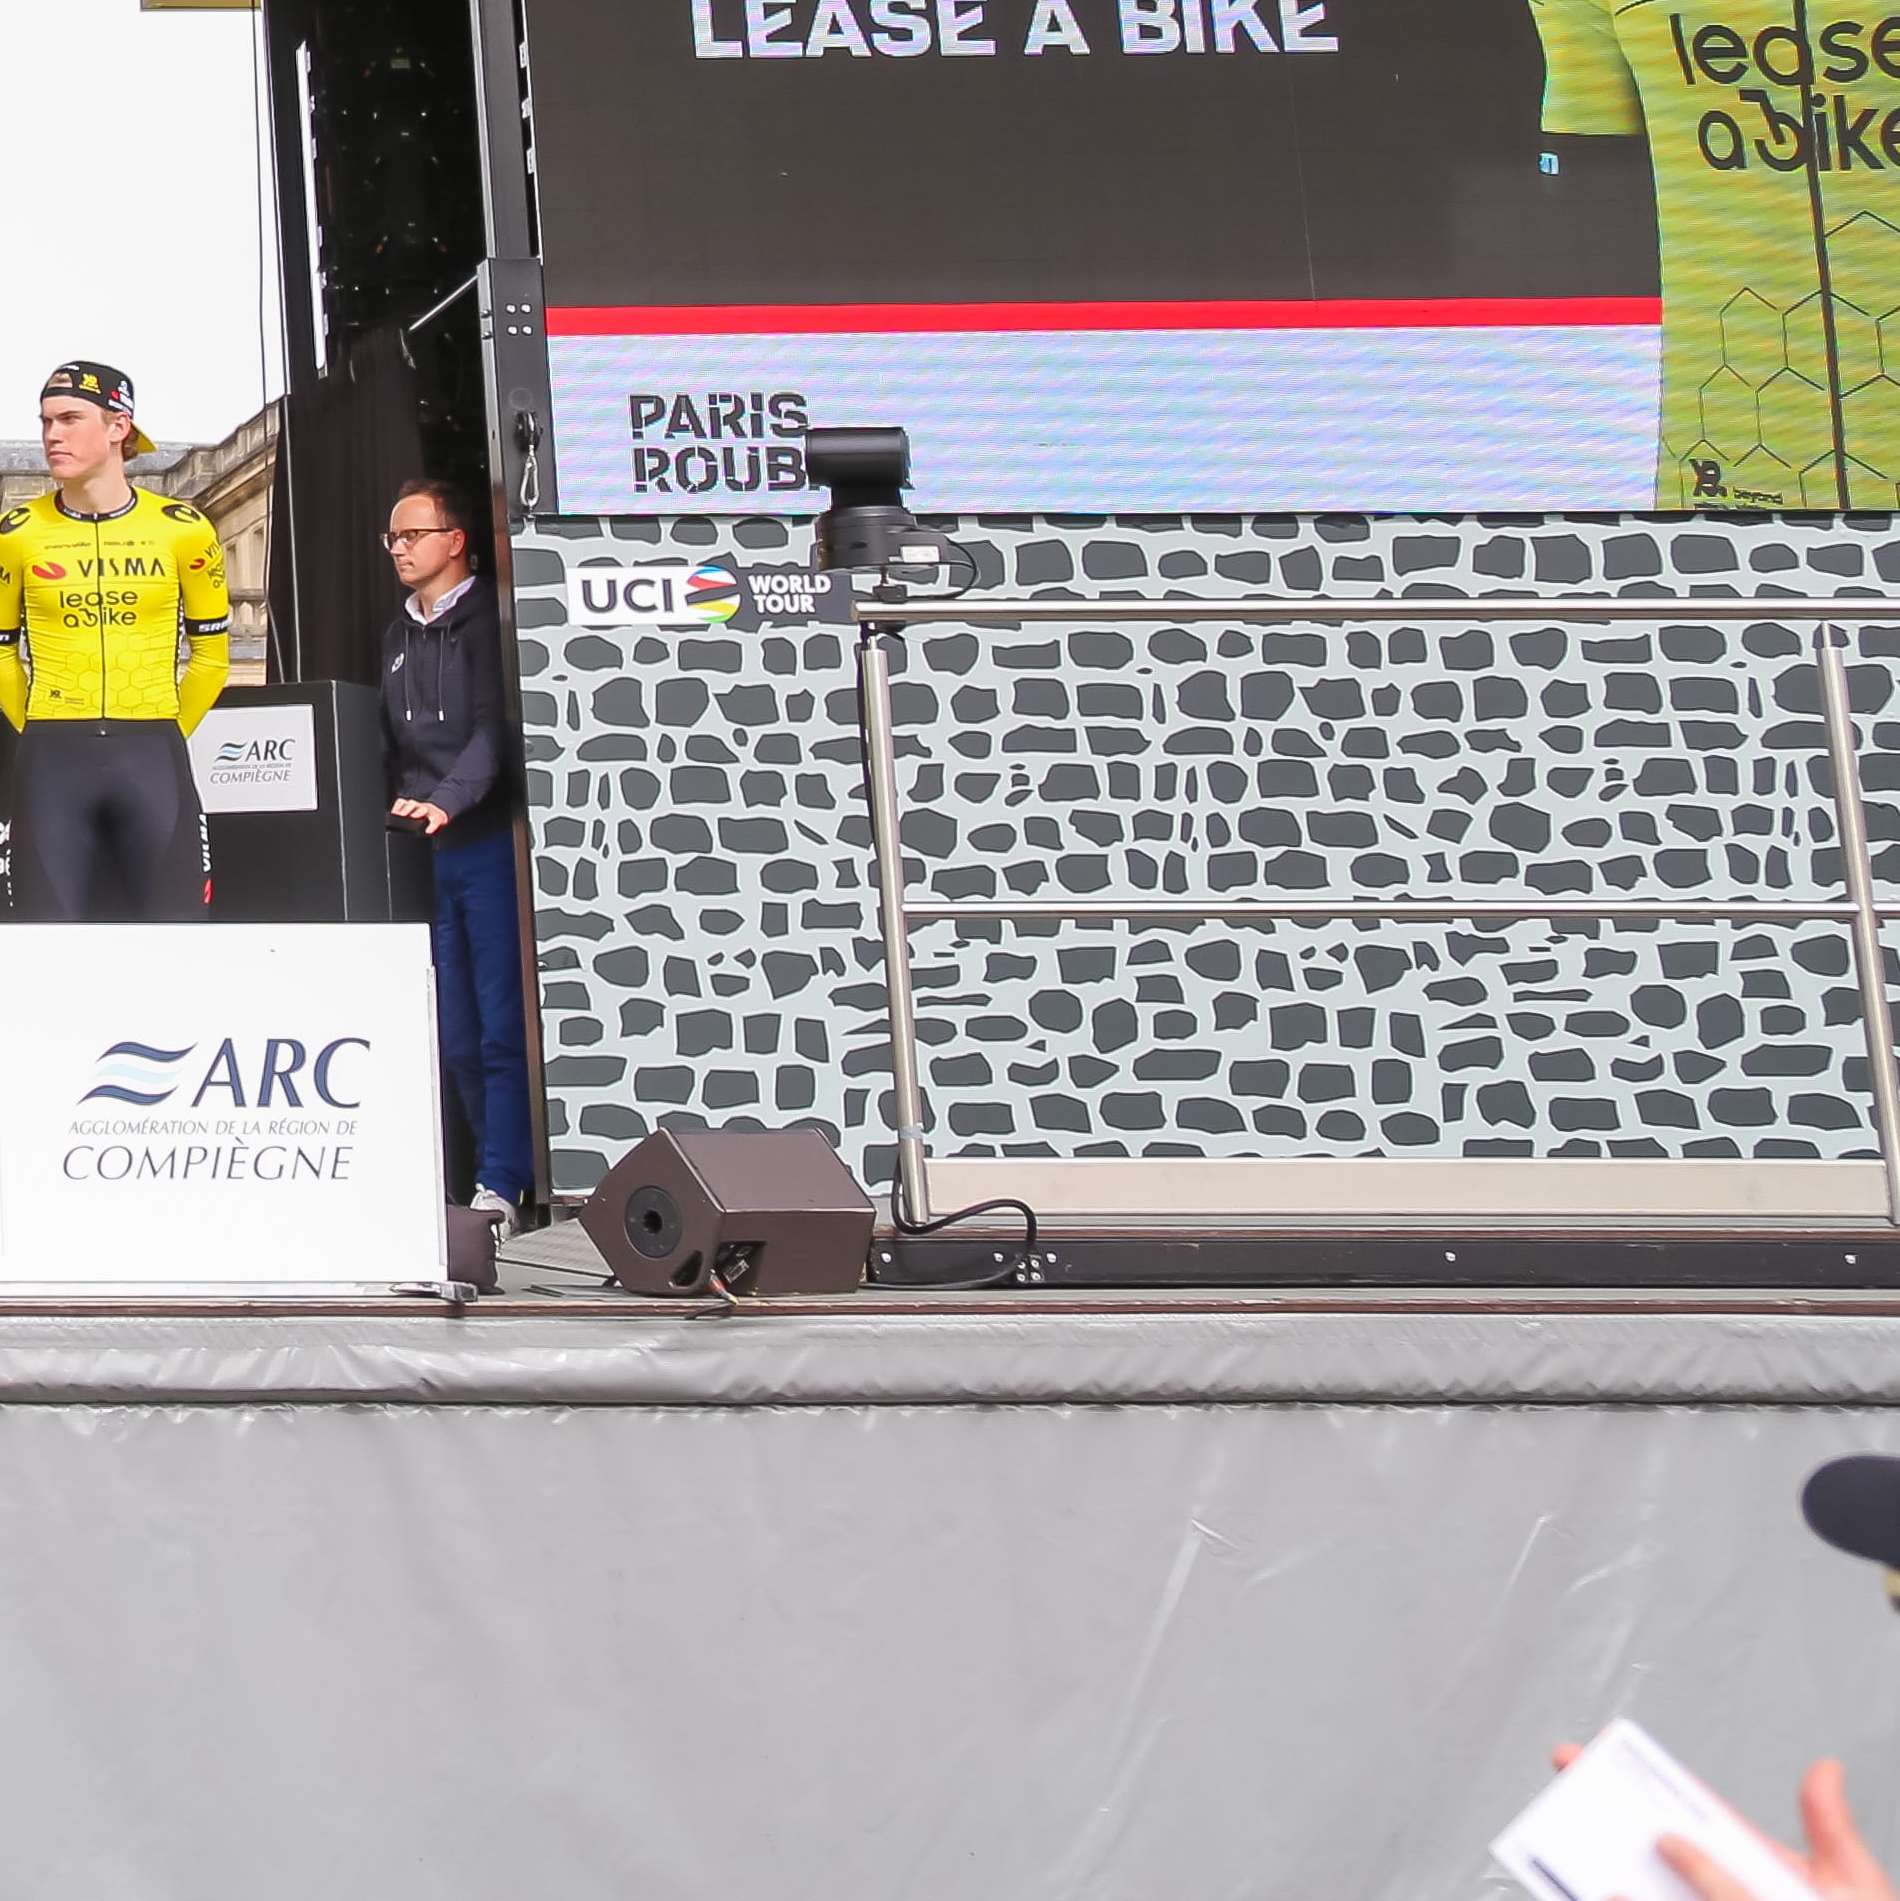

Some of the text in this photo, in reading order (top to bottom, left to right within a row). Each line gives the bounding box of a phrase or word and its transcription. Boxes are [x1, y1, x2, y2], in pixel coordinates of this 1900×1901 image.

[628, 392, 810, 439] PARIS
[632, 446, 813, 493] ROUB
[77, 557, 166, 578] VISMA
[580, 577, 675, 613] UCI
[747, 574, 833, 595] WORLD
[59, 590, 139, 609] lease
[753, 594, 817, 614] TOUR
[244, 738, 296, 762] ARC
[209, 769, 292, 785] COMPIÈGNE
[190, 1037, 371, 1110] ARC
[68, 1117, 358, 1135] AGGLOMÉRATION DE LA RÉGION DE
[62, 1137, 354, 1180] COMPIÈGNE
